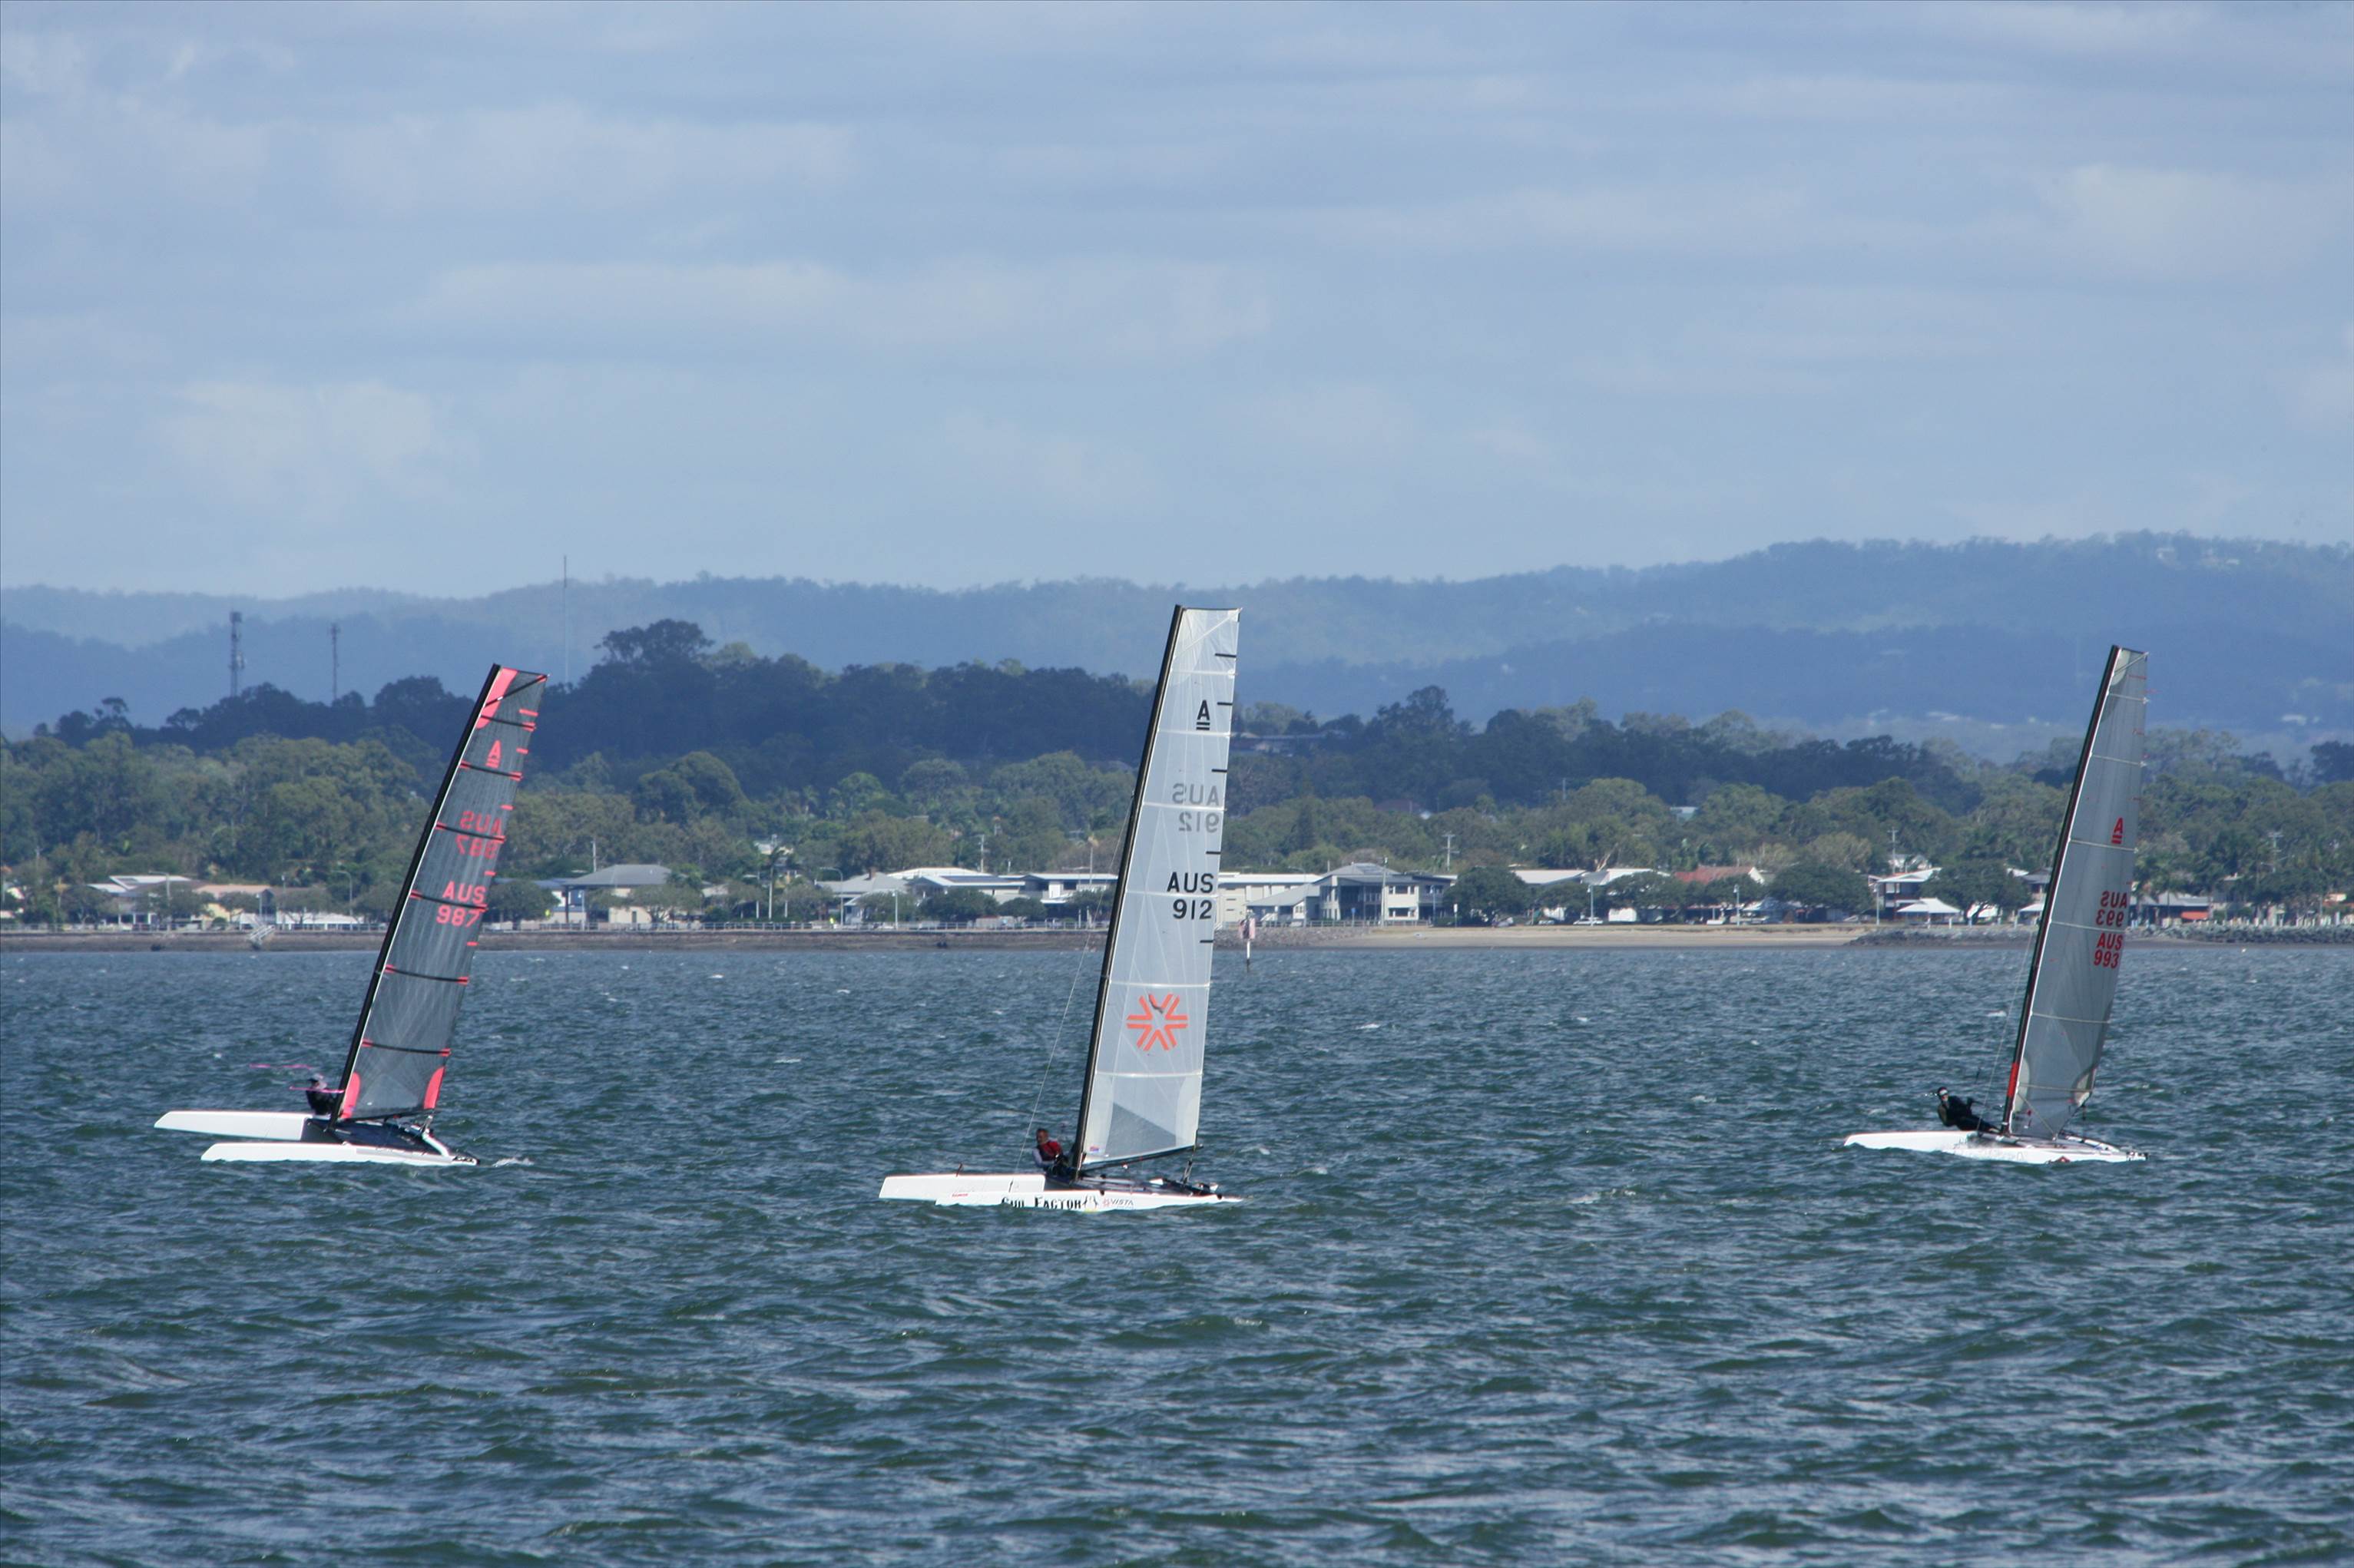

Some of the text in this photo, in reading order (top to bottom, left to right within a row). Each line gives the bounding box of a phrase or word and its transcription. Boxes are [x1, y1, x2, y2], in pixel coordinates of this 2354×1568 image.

[1197, 700, 1210, 721] A
[442, 881, 487, 904] AUS
[1167, 872, 1214, 894] AUS
[436, 905, 481, 928] 987
[1173, 898, 1213, 920] 912
[2097, 932, 2124, 951] AUS
[2094, 949, 2120, 969] 993
